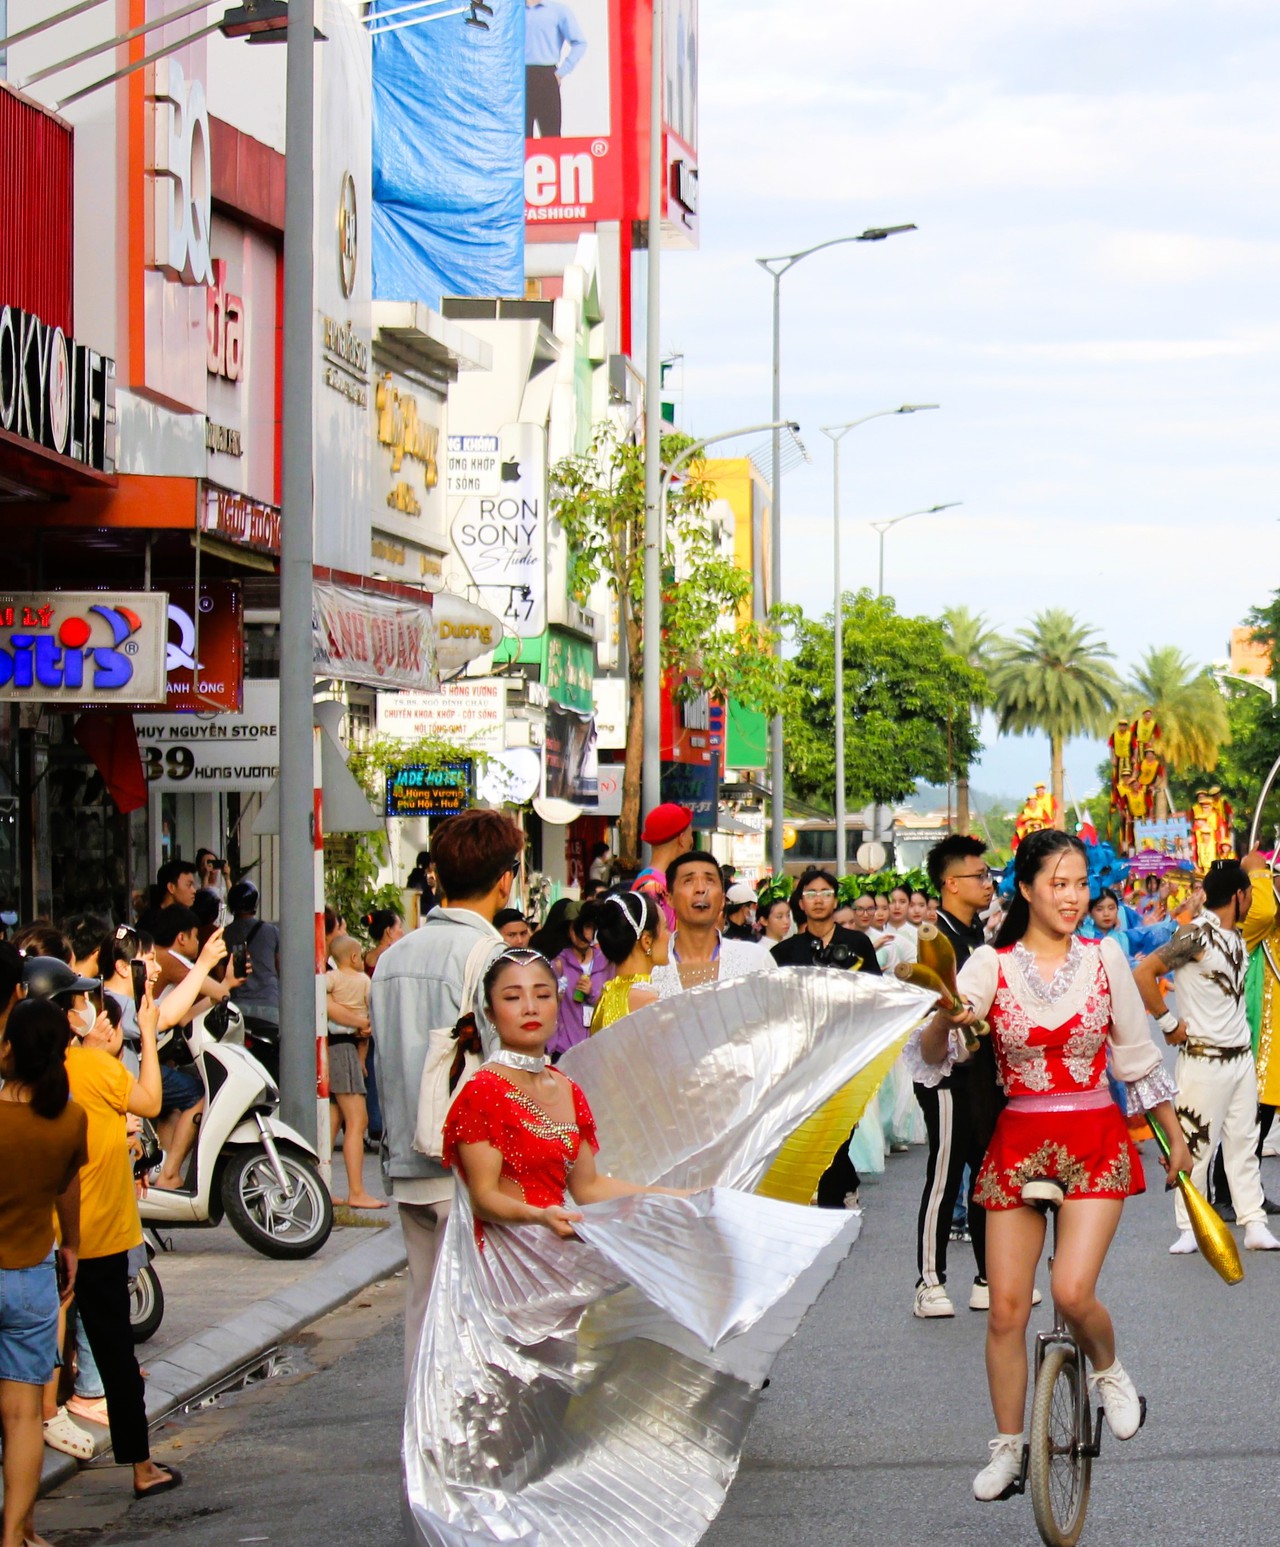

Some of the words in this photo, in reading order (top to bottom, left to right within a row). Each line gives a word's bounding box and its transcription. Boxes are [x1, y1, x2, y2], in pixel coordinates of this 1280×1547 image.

[480, 499, 538, 521] RON
[461, 524, 537, 546] SONY
[472, 547, 539, 573] Studio
[503, 599, 535, 621] 47
[136, 726, 165, 738] HUY
[231, 725, 277, 738] STORE
[394, 770, 424, 787] JADE
